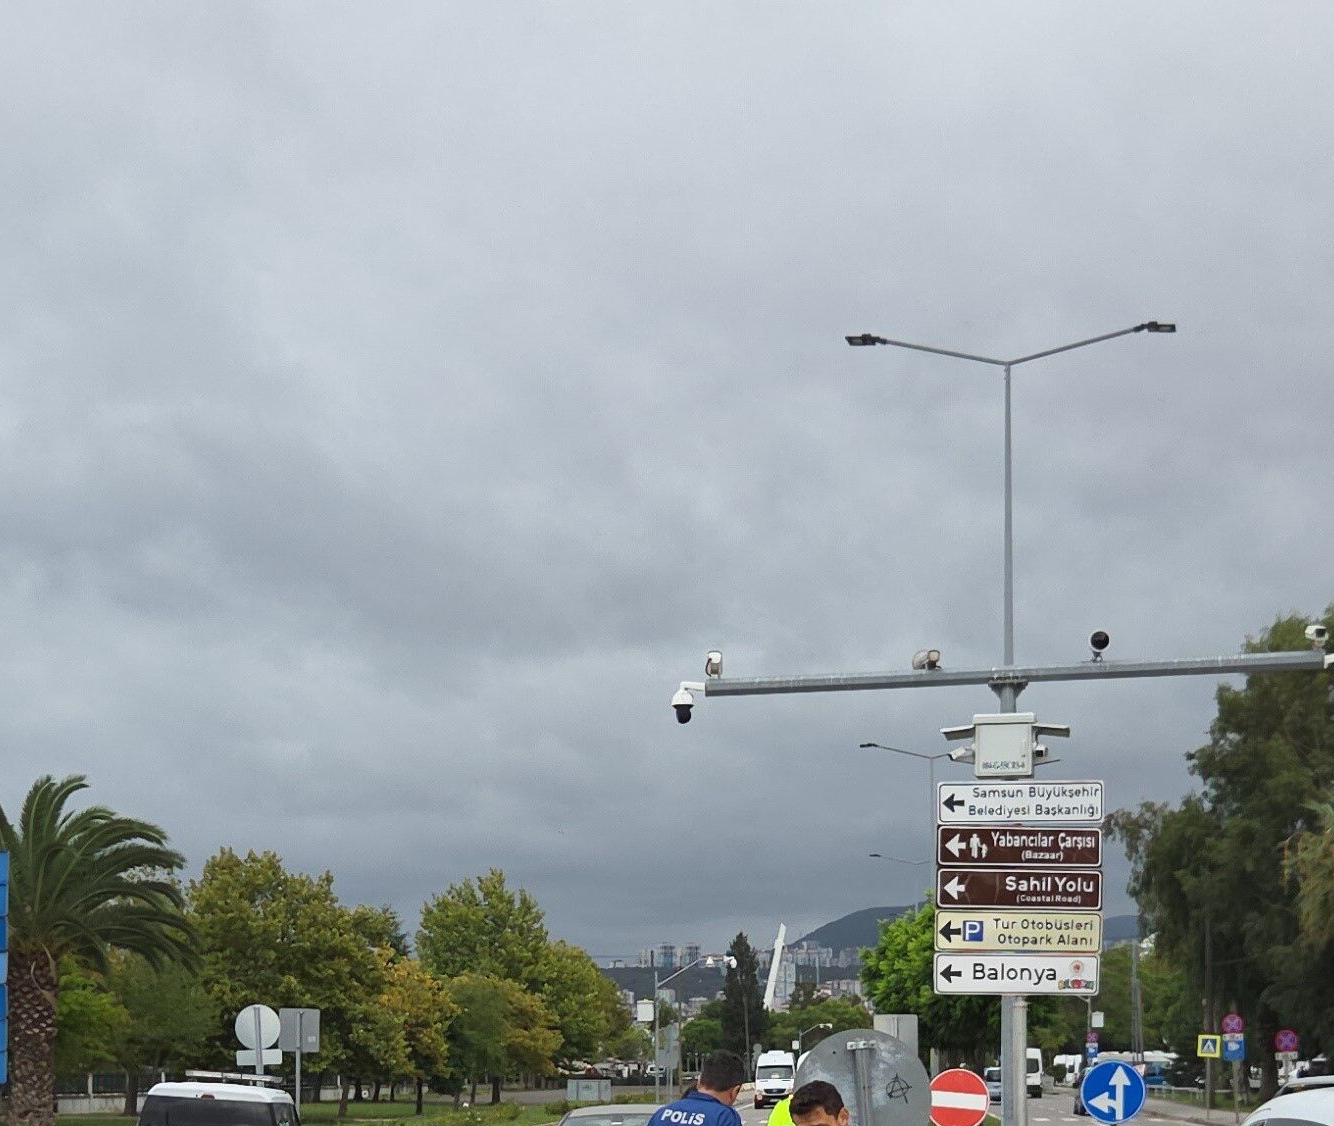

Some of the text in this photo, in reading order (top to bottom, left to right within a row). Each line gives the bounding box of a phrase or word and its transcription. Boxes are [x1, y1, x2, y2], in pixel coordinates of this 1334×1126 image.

[973, 786, 1100, 800] Samsun Büyükşehir
[969, 804, 1099, 818] Belediyesi Başkanlığı
[991, 831, 1095, 850] Yabancılar Çarşısı
[1021, 851, 1064, 861] (Bazaar)
[1005, 875, 1094, 893] Sahil Yolu
[1016, 894, 1082, 904] (Coastal Road)
[965, 921, 981, 941] P
[993, 918, 1093, 931] Tur Otobüsleri
[998, 933, 1093, 947] Otopark Alanı
[972, 963, 1057, 985] Balonya
